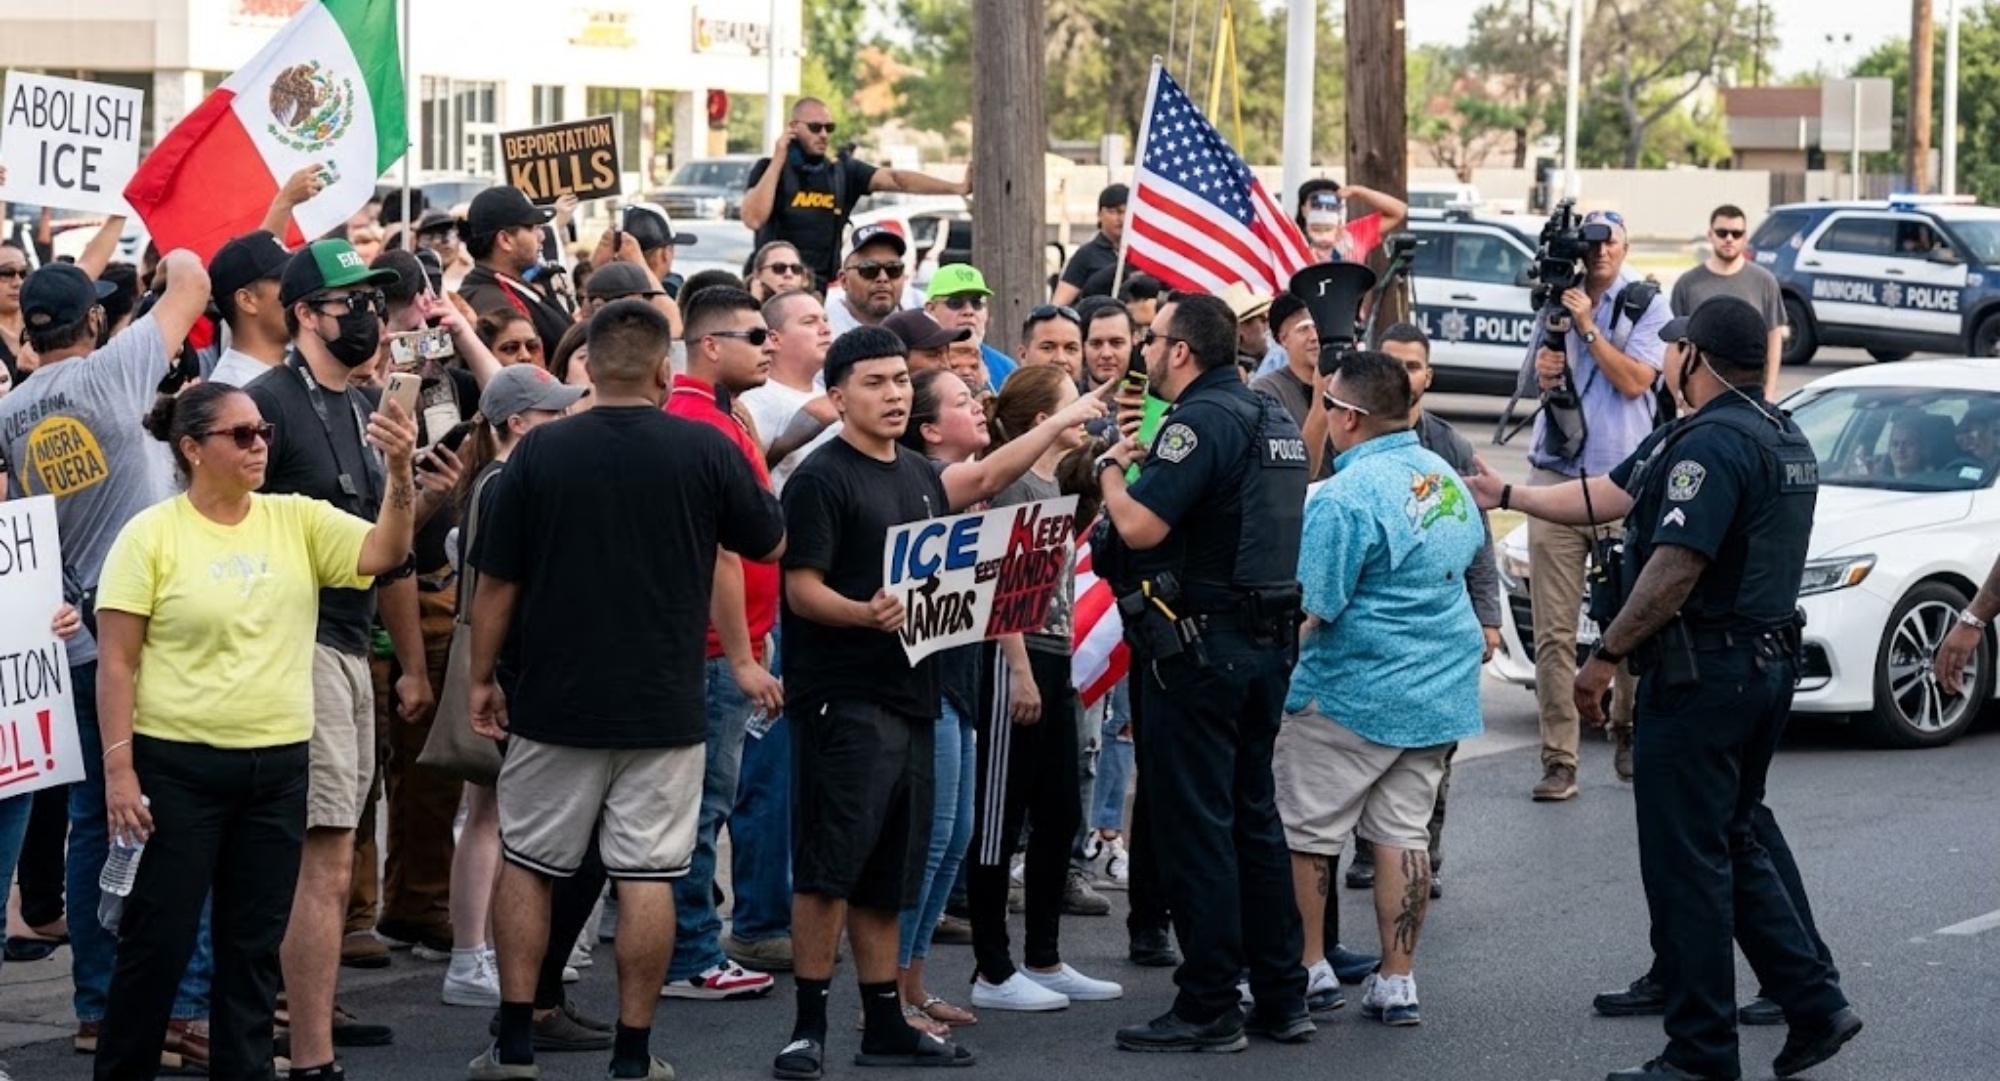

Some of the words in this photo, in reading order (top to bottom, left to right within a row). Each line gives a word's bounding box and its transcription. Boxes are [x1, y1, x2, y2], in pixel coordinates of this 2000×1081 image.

[8, 83, 133, 141] ABOLISH
[505, 123, 611, 160] DEPORTATION
[39, 140, 102, 192] ICE
[511, 149, 615, 199] KILLS
[1906, 286, 1958, 311] POLICE
[1474, 316, 1536, 343] POLIC
[42, 450, 104, 491] FUERA
[890, 515, 985, 586] ICE
